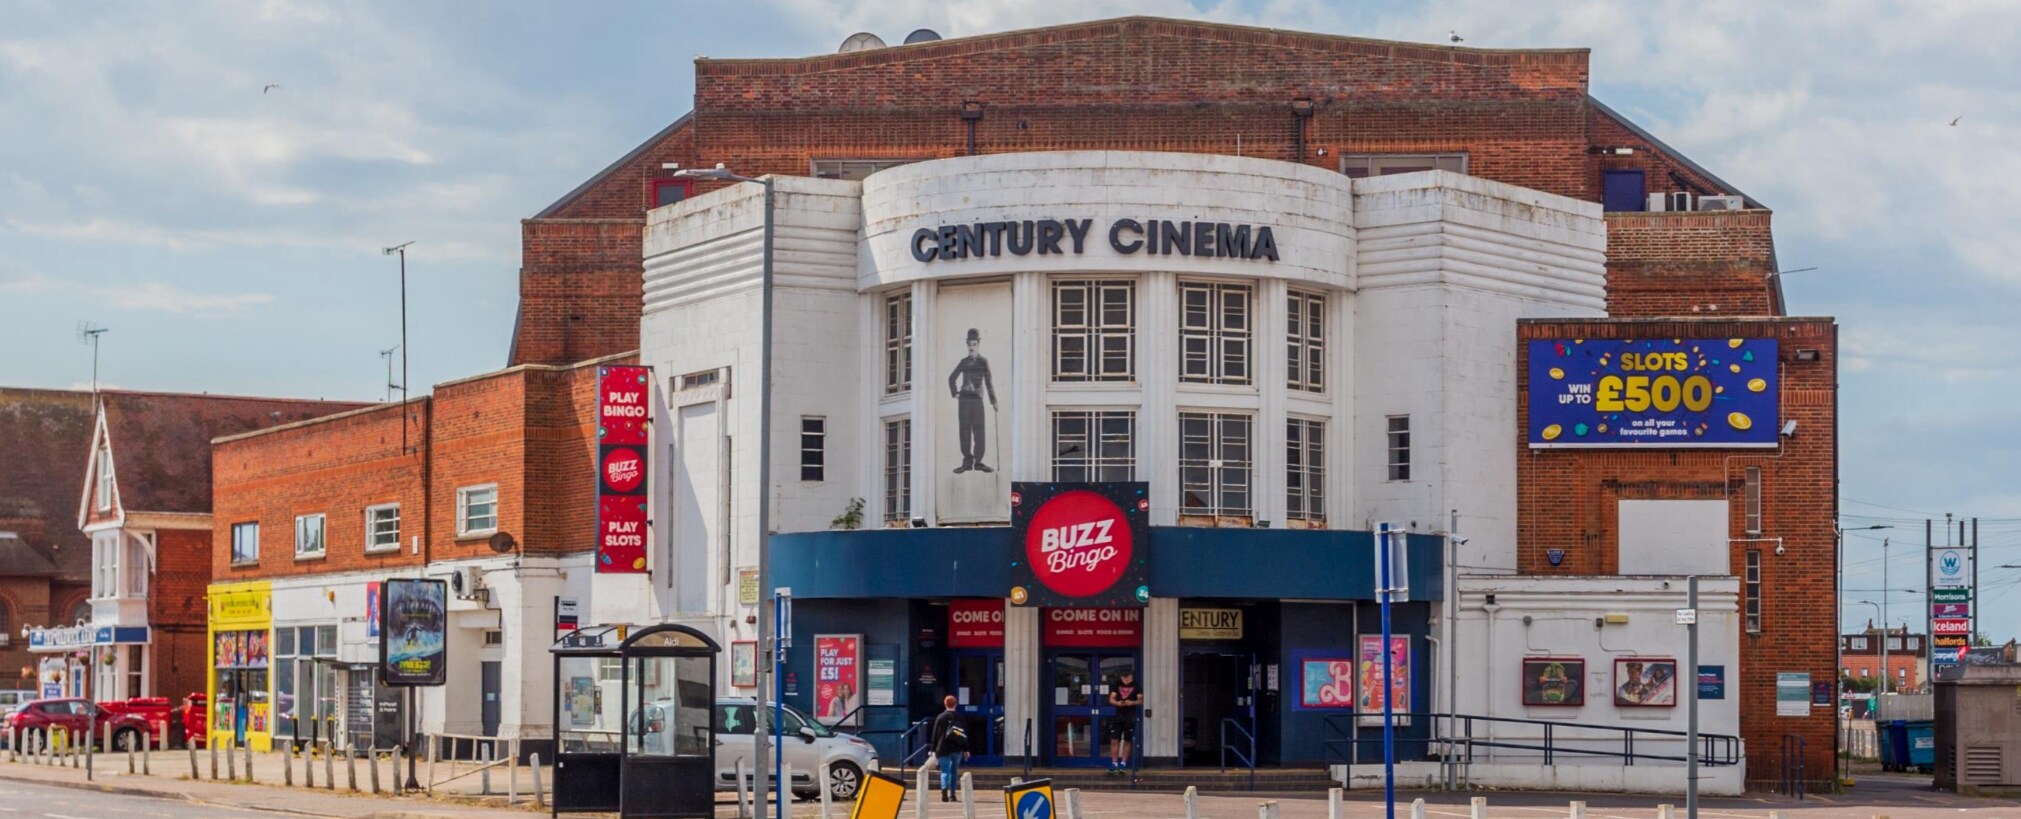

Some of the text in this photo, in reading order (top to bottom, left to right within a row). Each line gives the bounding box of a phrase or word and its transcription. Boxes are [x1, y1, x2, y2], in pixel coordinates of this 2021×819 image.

[911, 218, 1280, 262] CENTURY CINEMA
[1621, 353, 1688, 370] SLOTS
[1568, 384, 1591, 394] WIN
[1596, 375, 1712, 412] £500
[609, 392, 639, 403] PLAY
[1559, 394, 1591, 404] UP TO
[604, 405, 645, 417] BINGO
[1657, 420, 1675, 428] your
[1620, 427, 1687, 437] favourite games
[608, 459, 637, 473] BUZZ
[610, 471, 638, 483] Bingo
[608, 521, 638, 533] PLAY
[605, 534, 642, 546] SLOTS
[1041, 519, 1115, 552] BUZZ
[1047, 545, 1118, 573] Bingo
[1944, 557, 1957, 568] W
[952, 611, 990, 623] COME
[1051, 609, 1139, 622] COME ON IN
[1181, 610, 1240, 628] ENTURY
[1934, 621, 1967, 631] Iceland
[664, 637, 679, 646] Aldi
[1935, 637, 1966, 646] halfords
[820, 648, 839, 657] PLAY
[820, 657, 853, 665] FOR JUST
[820, 667, 839, 680] £5!
